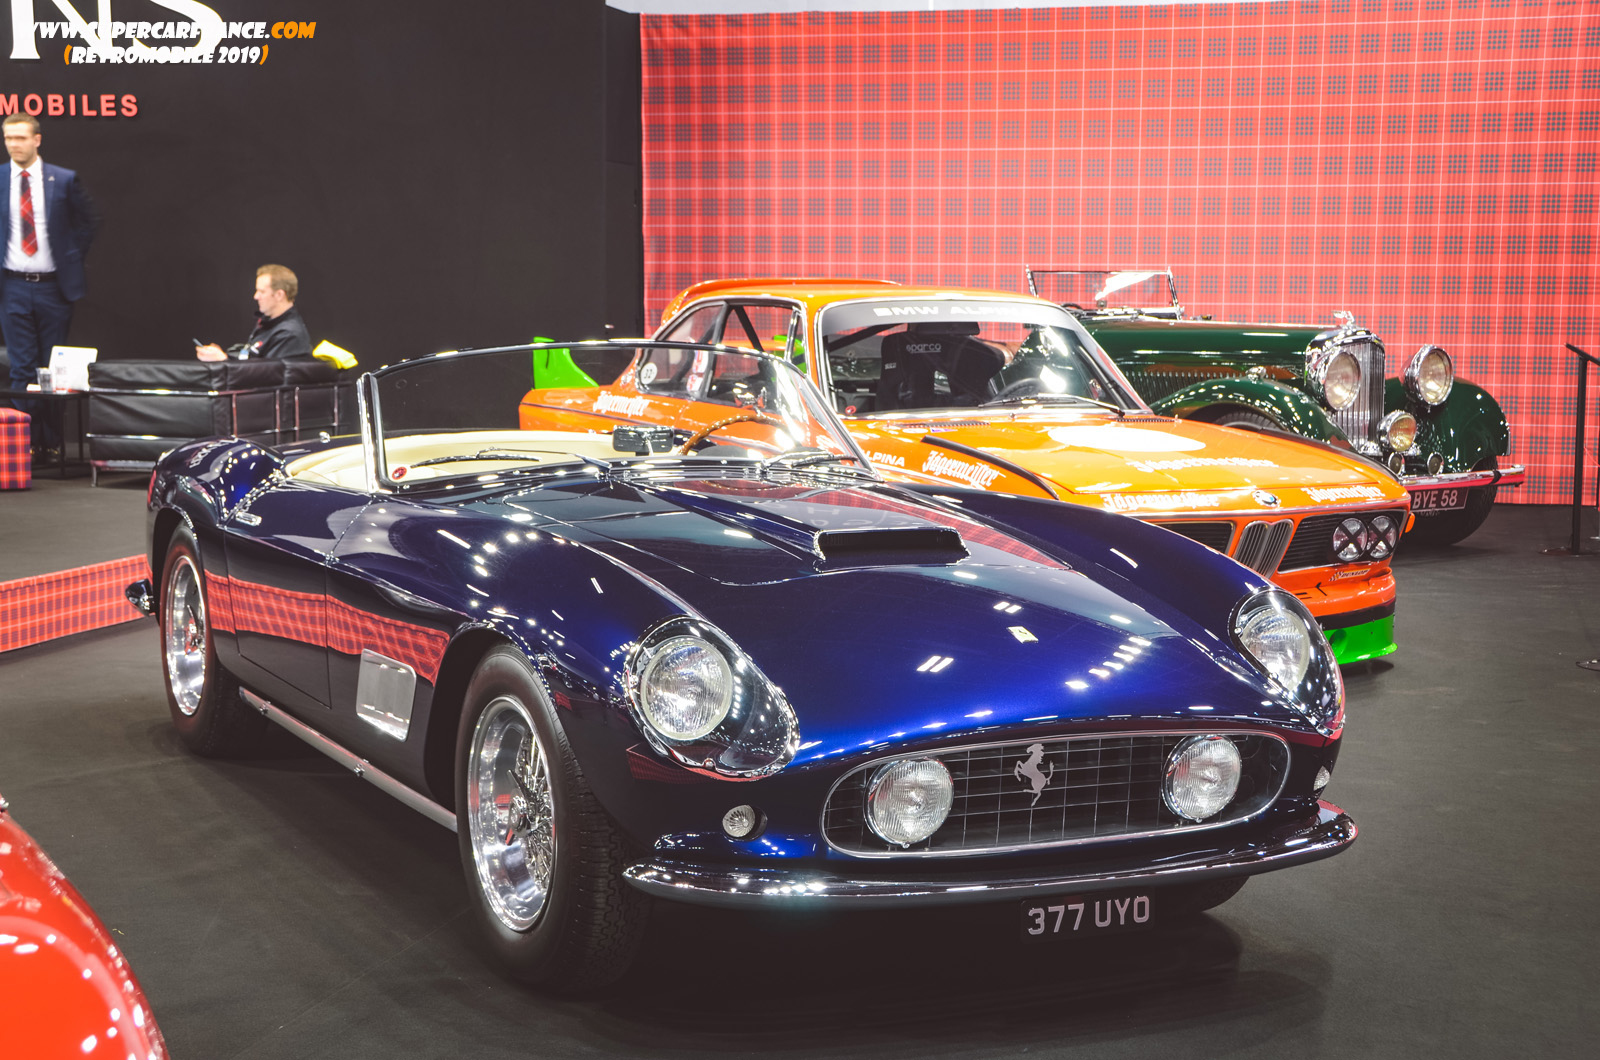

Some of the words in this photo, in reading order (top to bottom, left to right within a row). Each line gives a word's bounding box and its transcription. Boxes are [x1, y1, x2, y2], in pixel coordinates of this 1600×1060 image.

[873, 306, 939, 317] BMW
[951, 306, 1022, 317] ALPIN
[1412, 490, 1439, 509] BYE
[1440, 489, 1458, 507] 58
[1028, 903, 1085, 935] 377
[1095, 896, 1150, 928] UYO
